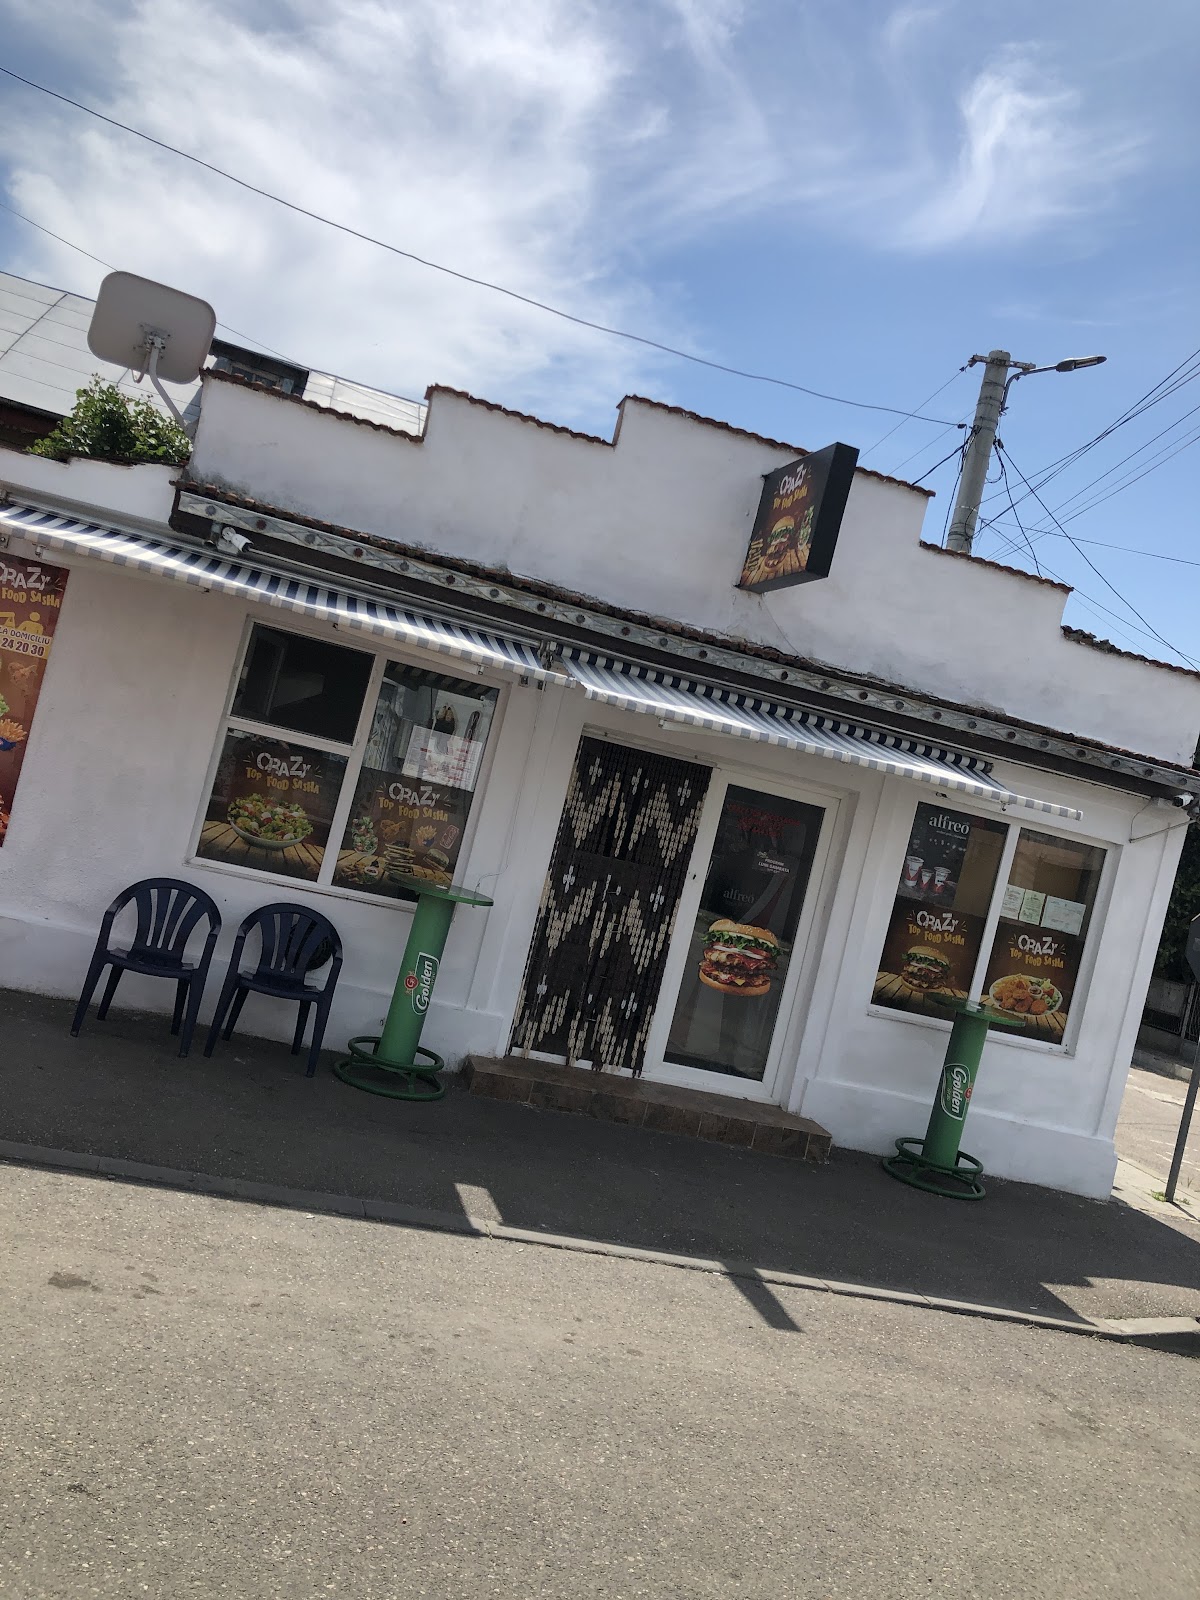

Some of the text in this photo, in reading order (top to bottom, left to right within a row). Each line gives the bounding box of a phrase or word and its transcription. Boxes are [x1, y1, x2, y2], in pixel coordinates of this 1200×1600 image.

[2, 587, 61, 608] FOOD SASHA
[1, 637, 45, 657] 24 20 30
[10, 629, 51, 645] DOMICILIU
[246, 767, 320, 795] TOP FOOD SASHA
[378, 796, 449, 822] TOP FOOD SASHA
[908, 923, 965, 946] TOP FOOD SASHA
[1009, 947, 1064, 969] TOP FOOD SASHA
[415, 960, 433, 1010] Golden
[951, 1067, 967, 1114] Golden
